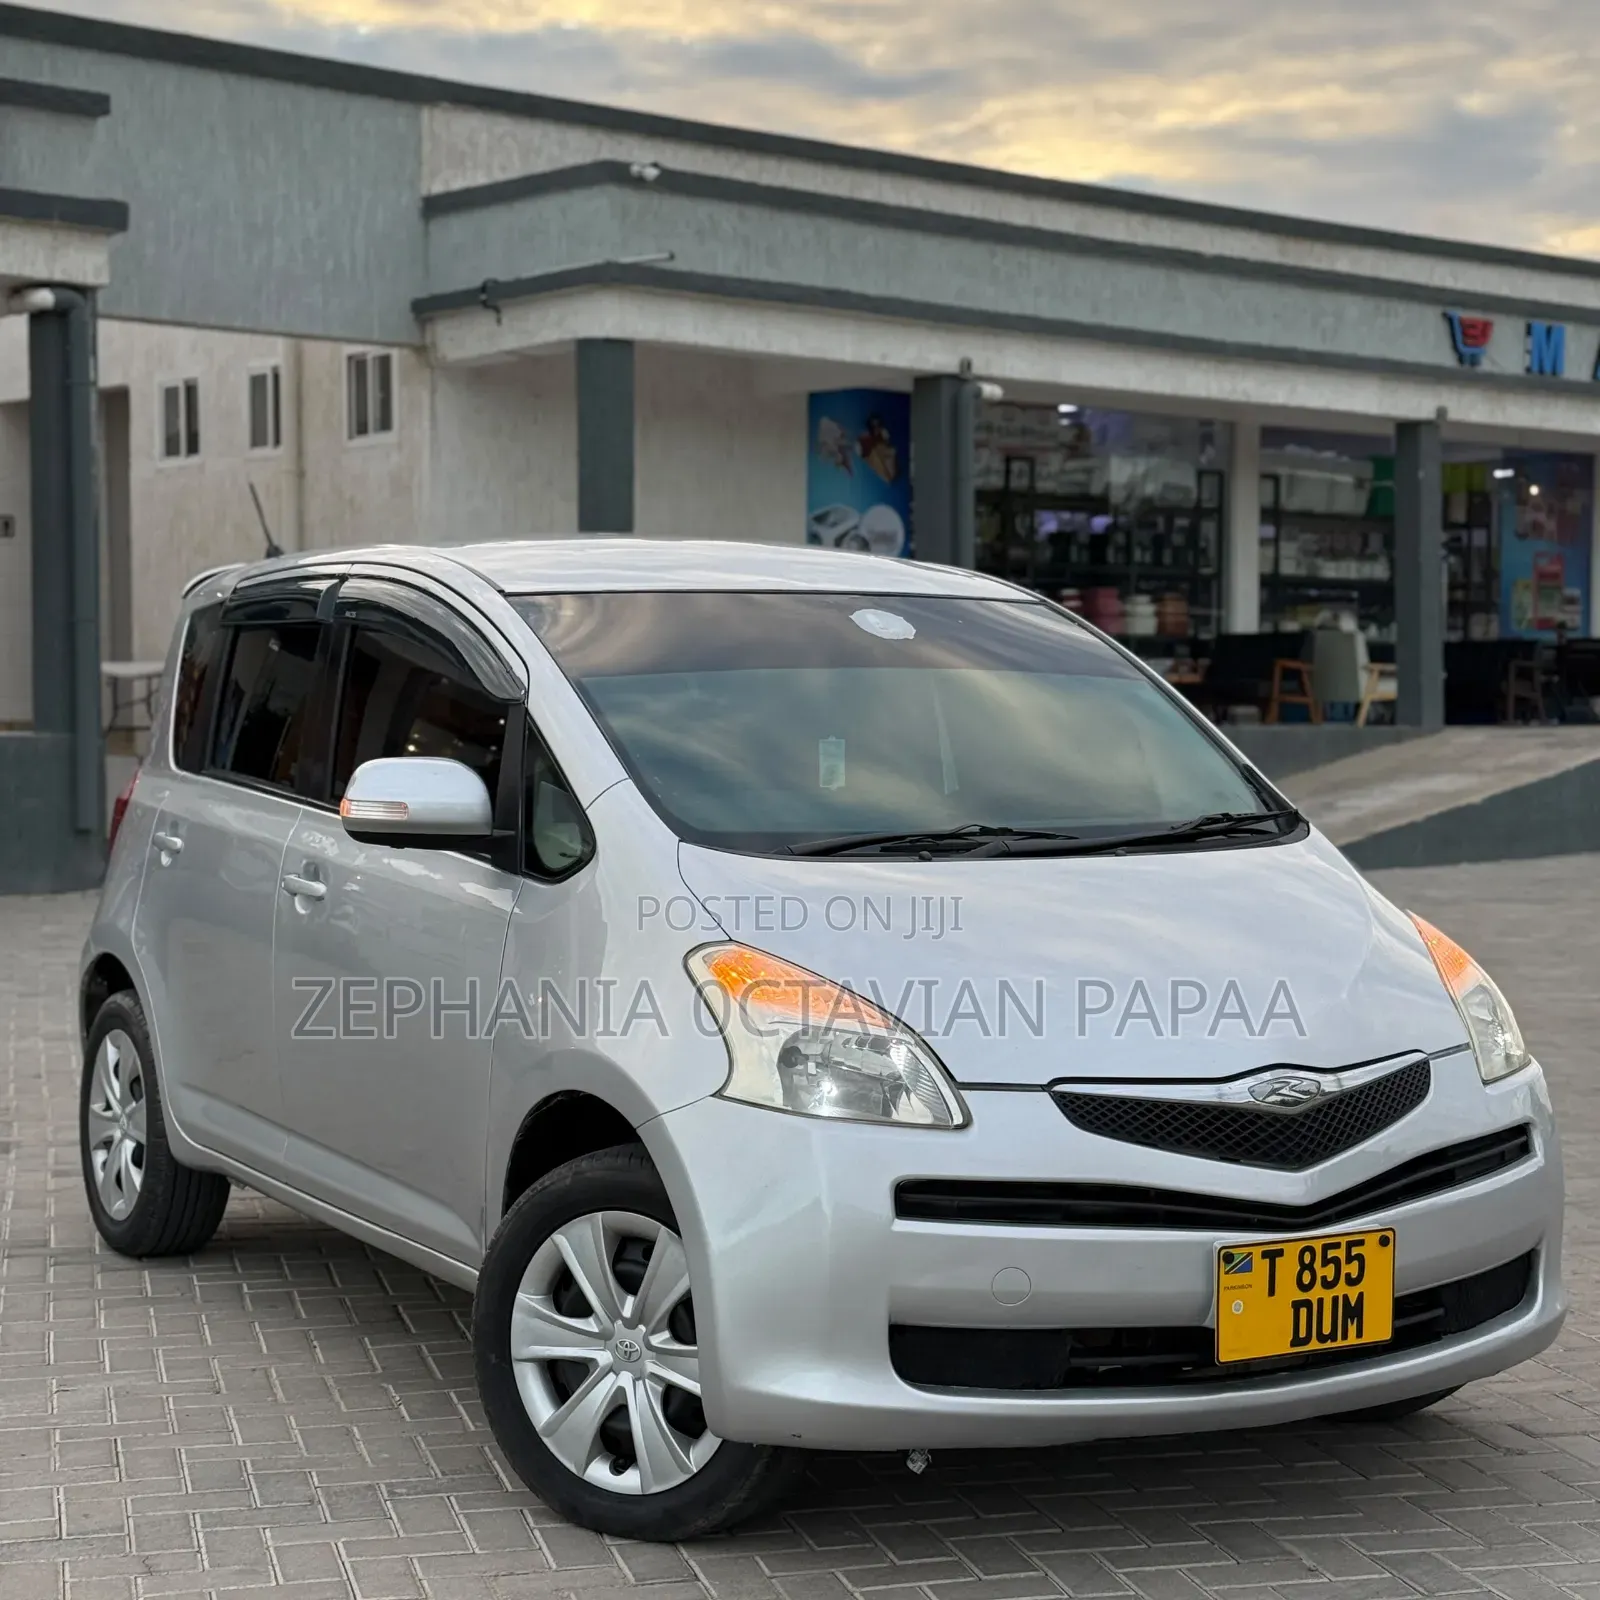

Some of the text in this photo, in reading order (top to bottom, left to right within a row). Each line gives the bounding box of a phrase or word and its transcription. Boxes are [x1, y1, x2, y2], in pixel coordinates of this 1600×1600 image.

[1261, 1238, 1366, 1298] T 855
[1289, 1291, 1364, 1349] DUM
